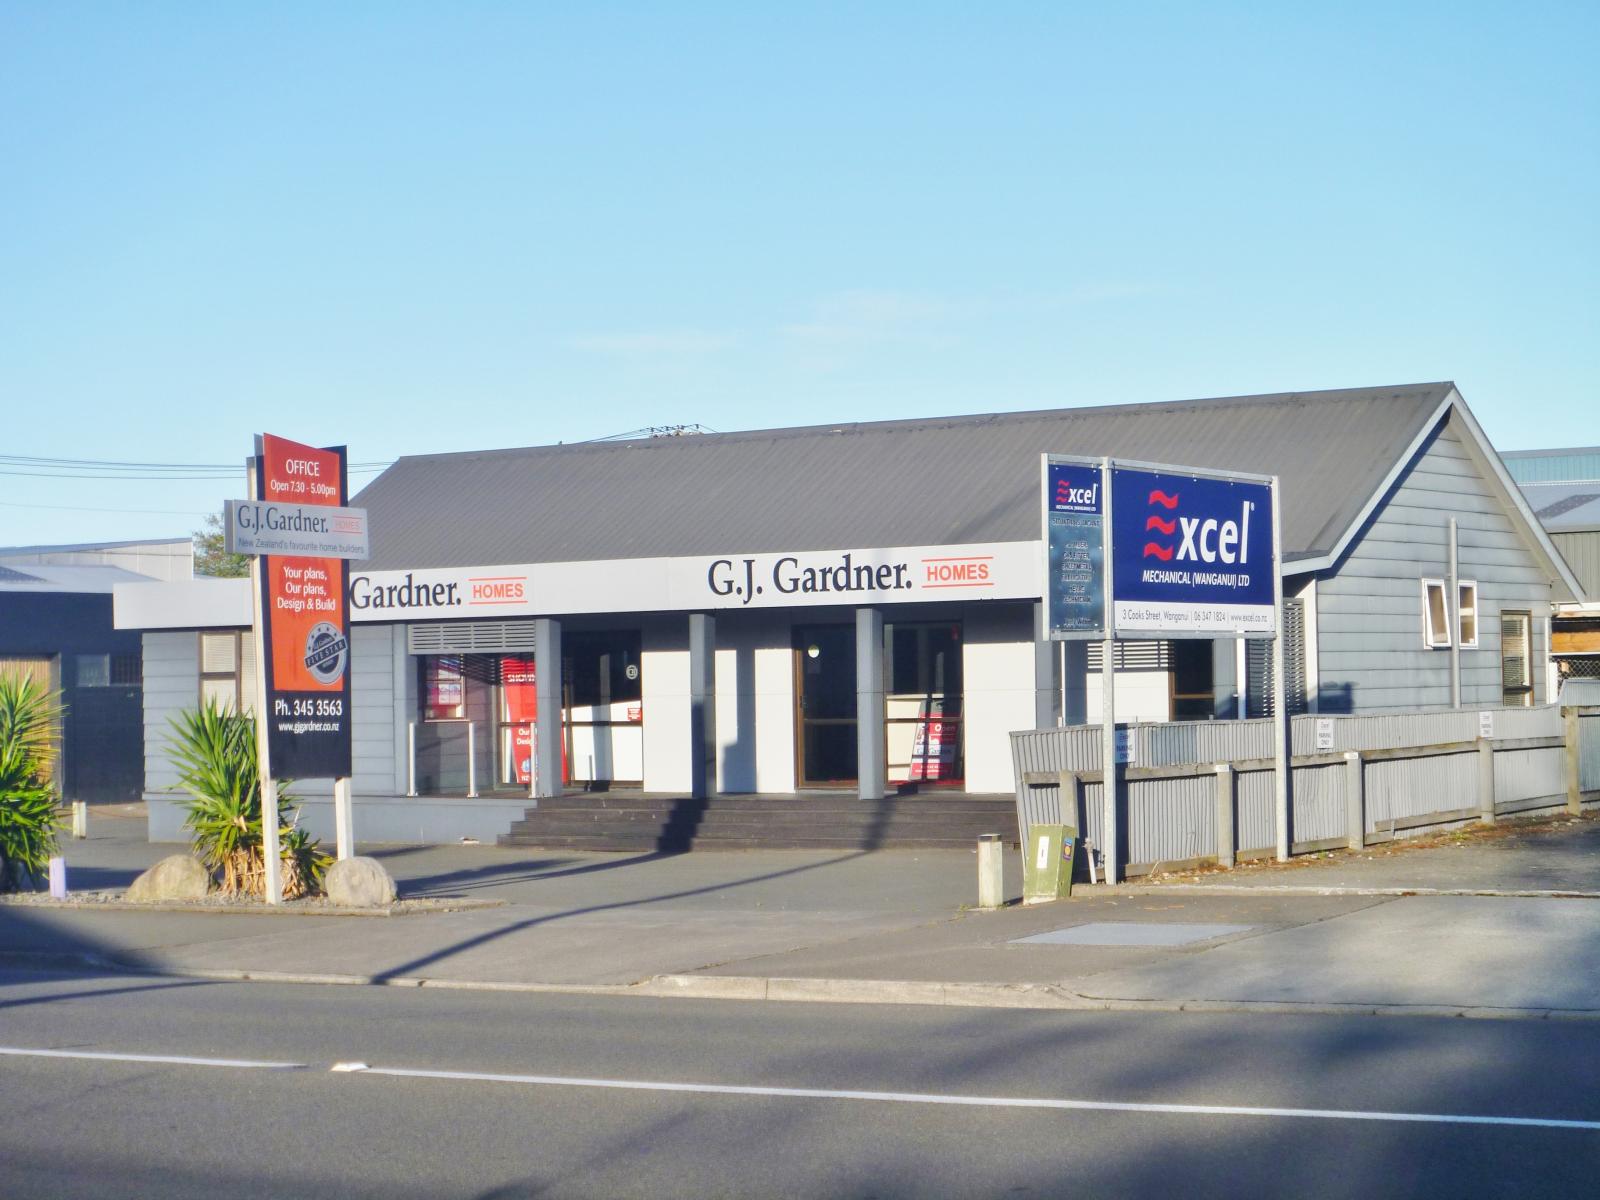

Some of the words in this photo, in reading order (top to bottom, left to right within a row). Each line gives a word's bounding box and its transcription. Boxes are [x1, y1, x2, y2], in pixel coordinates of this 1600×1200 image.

[286, 459, 320, 477] OFFICE
[270, 479, 289, 493] Open
[310, 483, 336, 498] 5.00pm
[238, 505, 264, 534] G.J.
[265, 506, 329, 533] Gardner.
[335, 519, 361, 530] HOMES
[238, 538, 254, 548] New
[255, 538, 288, 550] Zealand's
[289, 540, 319, 551] favourite
[319, 541, 337, 551] home
[338, 543, 365, 554] builders
[283, 566, 302, 580] Your
[303, 567, 328, 582] plans,
[708, 559, 763, 604] G.J.
[773, 553, 912, 595] Gardner.
[927, 563, 989, 581] HOMES
[1142, 570, 1191, 585] MECHANICAL
[1192, 573, 1237, 589] (WANGANUI)
[1238, 574, 1250, 586] LTD
[285, 582, 302, 595] Our
[303, 583, 327, 597] plans,
[350, 573, 462, 609] Gardner.
[472, 583, 524, 599] HOMES
[277, 597, 305, 613] Design
[306, 599, 314, 611] &
[315, 597, 336, 611] Build
[1122, 609, 1127, 620] 3
[1127, 609, 1145, 621] Cooks
[1145, 610, 1162, 622] Street,
[1163, 612, 1189, 623] Wanganui
[1202, 612, 1212, 622] 347
[1213, 612, 1226, 622] 1824
[1230, 614, 1268, 624] www.excel.co.nz
[325, 641, 344, 657] STAR
[275, 699, 291, 716] Ph.
[293, 700, 314, 717] 345
[316, 699, 342, 716] 3563
[278, 721, 340, 735] www.gjgardner.co.nz
